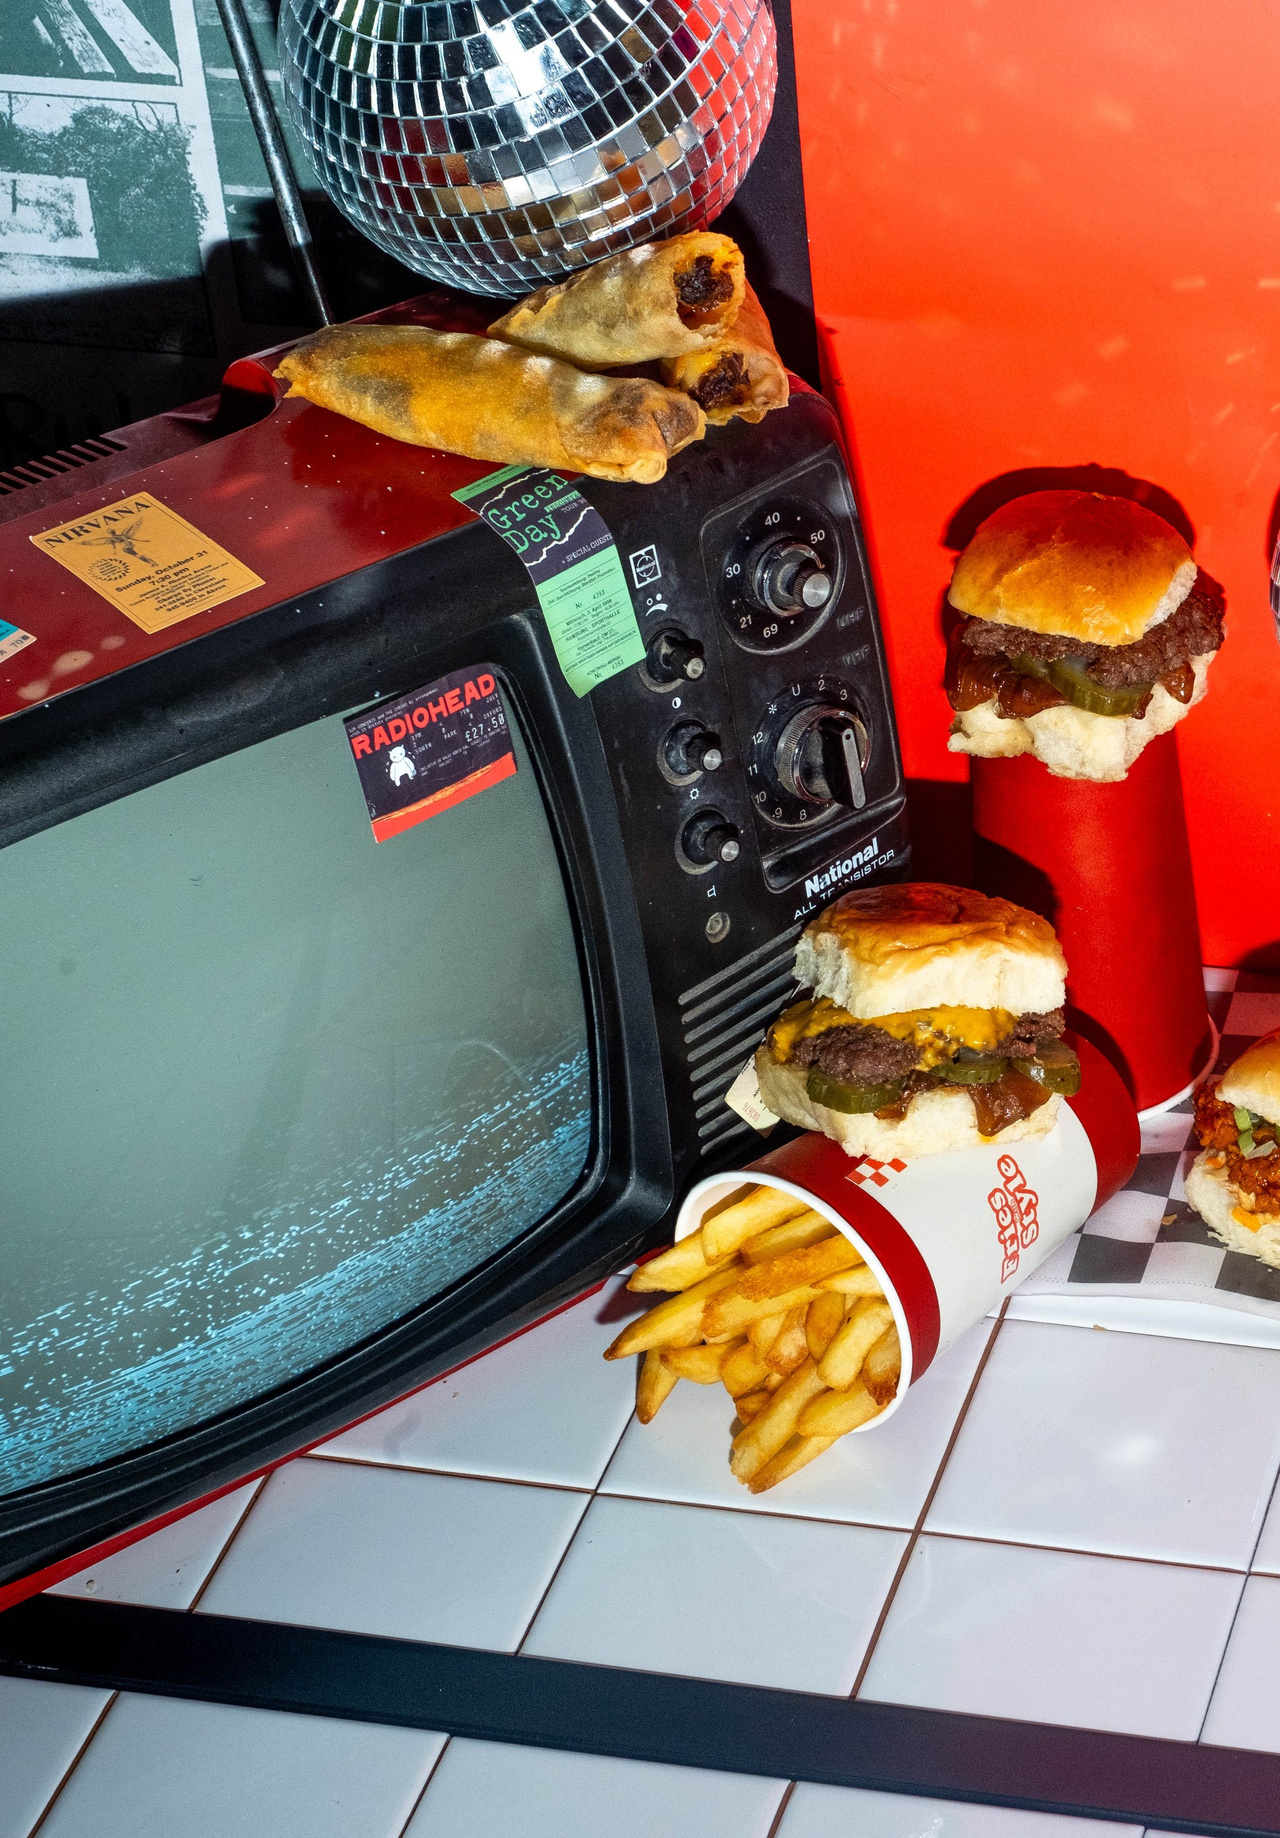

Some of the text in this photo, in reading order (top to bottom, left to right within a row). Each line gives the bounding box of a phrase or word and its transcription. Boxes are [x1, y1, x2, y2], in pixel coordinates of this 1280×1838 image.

[487, 474, 569, 529] Green
[43, 501, 152, 548] NIRVANA
[765, 512, 780, 526] 40
[502, 513, 561, 554] Day
[810, 530, 825, 543] 50
[565, 546, 592, 563] SPECIAL
[115, 574, 154, 591] Sunday,
[154, 556, 195, 574] October
[725, 564, 740, 578] 30
[149, 575, 171, 585] 7:30
[740, 615, 752, 628] 21
[763, 624, 778, 638] 69
[792, 684, 800, 696] U
[818, 680, 825, 690] 2
[840, 689, 847, 700] 3
[351, 673, 496, 760] RADIOHEAD
[465, 713, 505, 743] £27.50
[752, 732, 763, 745] 12
[748, 764, 758, 776] 11
[755, 791, 766, 803] 10
[800, 809, 807, 820] 8
[805, 837, 878, 898] National
[794, 902, 816, 920] ALL
[997, 1154, 1039, 1249] Style
[988, 1188, 1019, 1284] Fries
